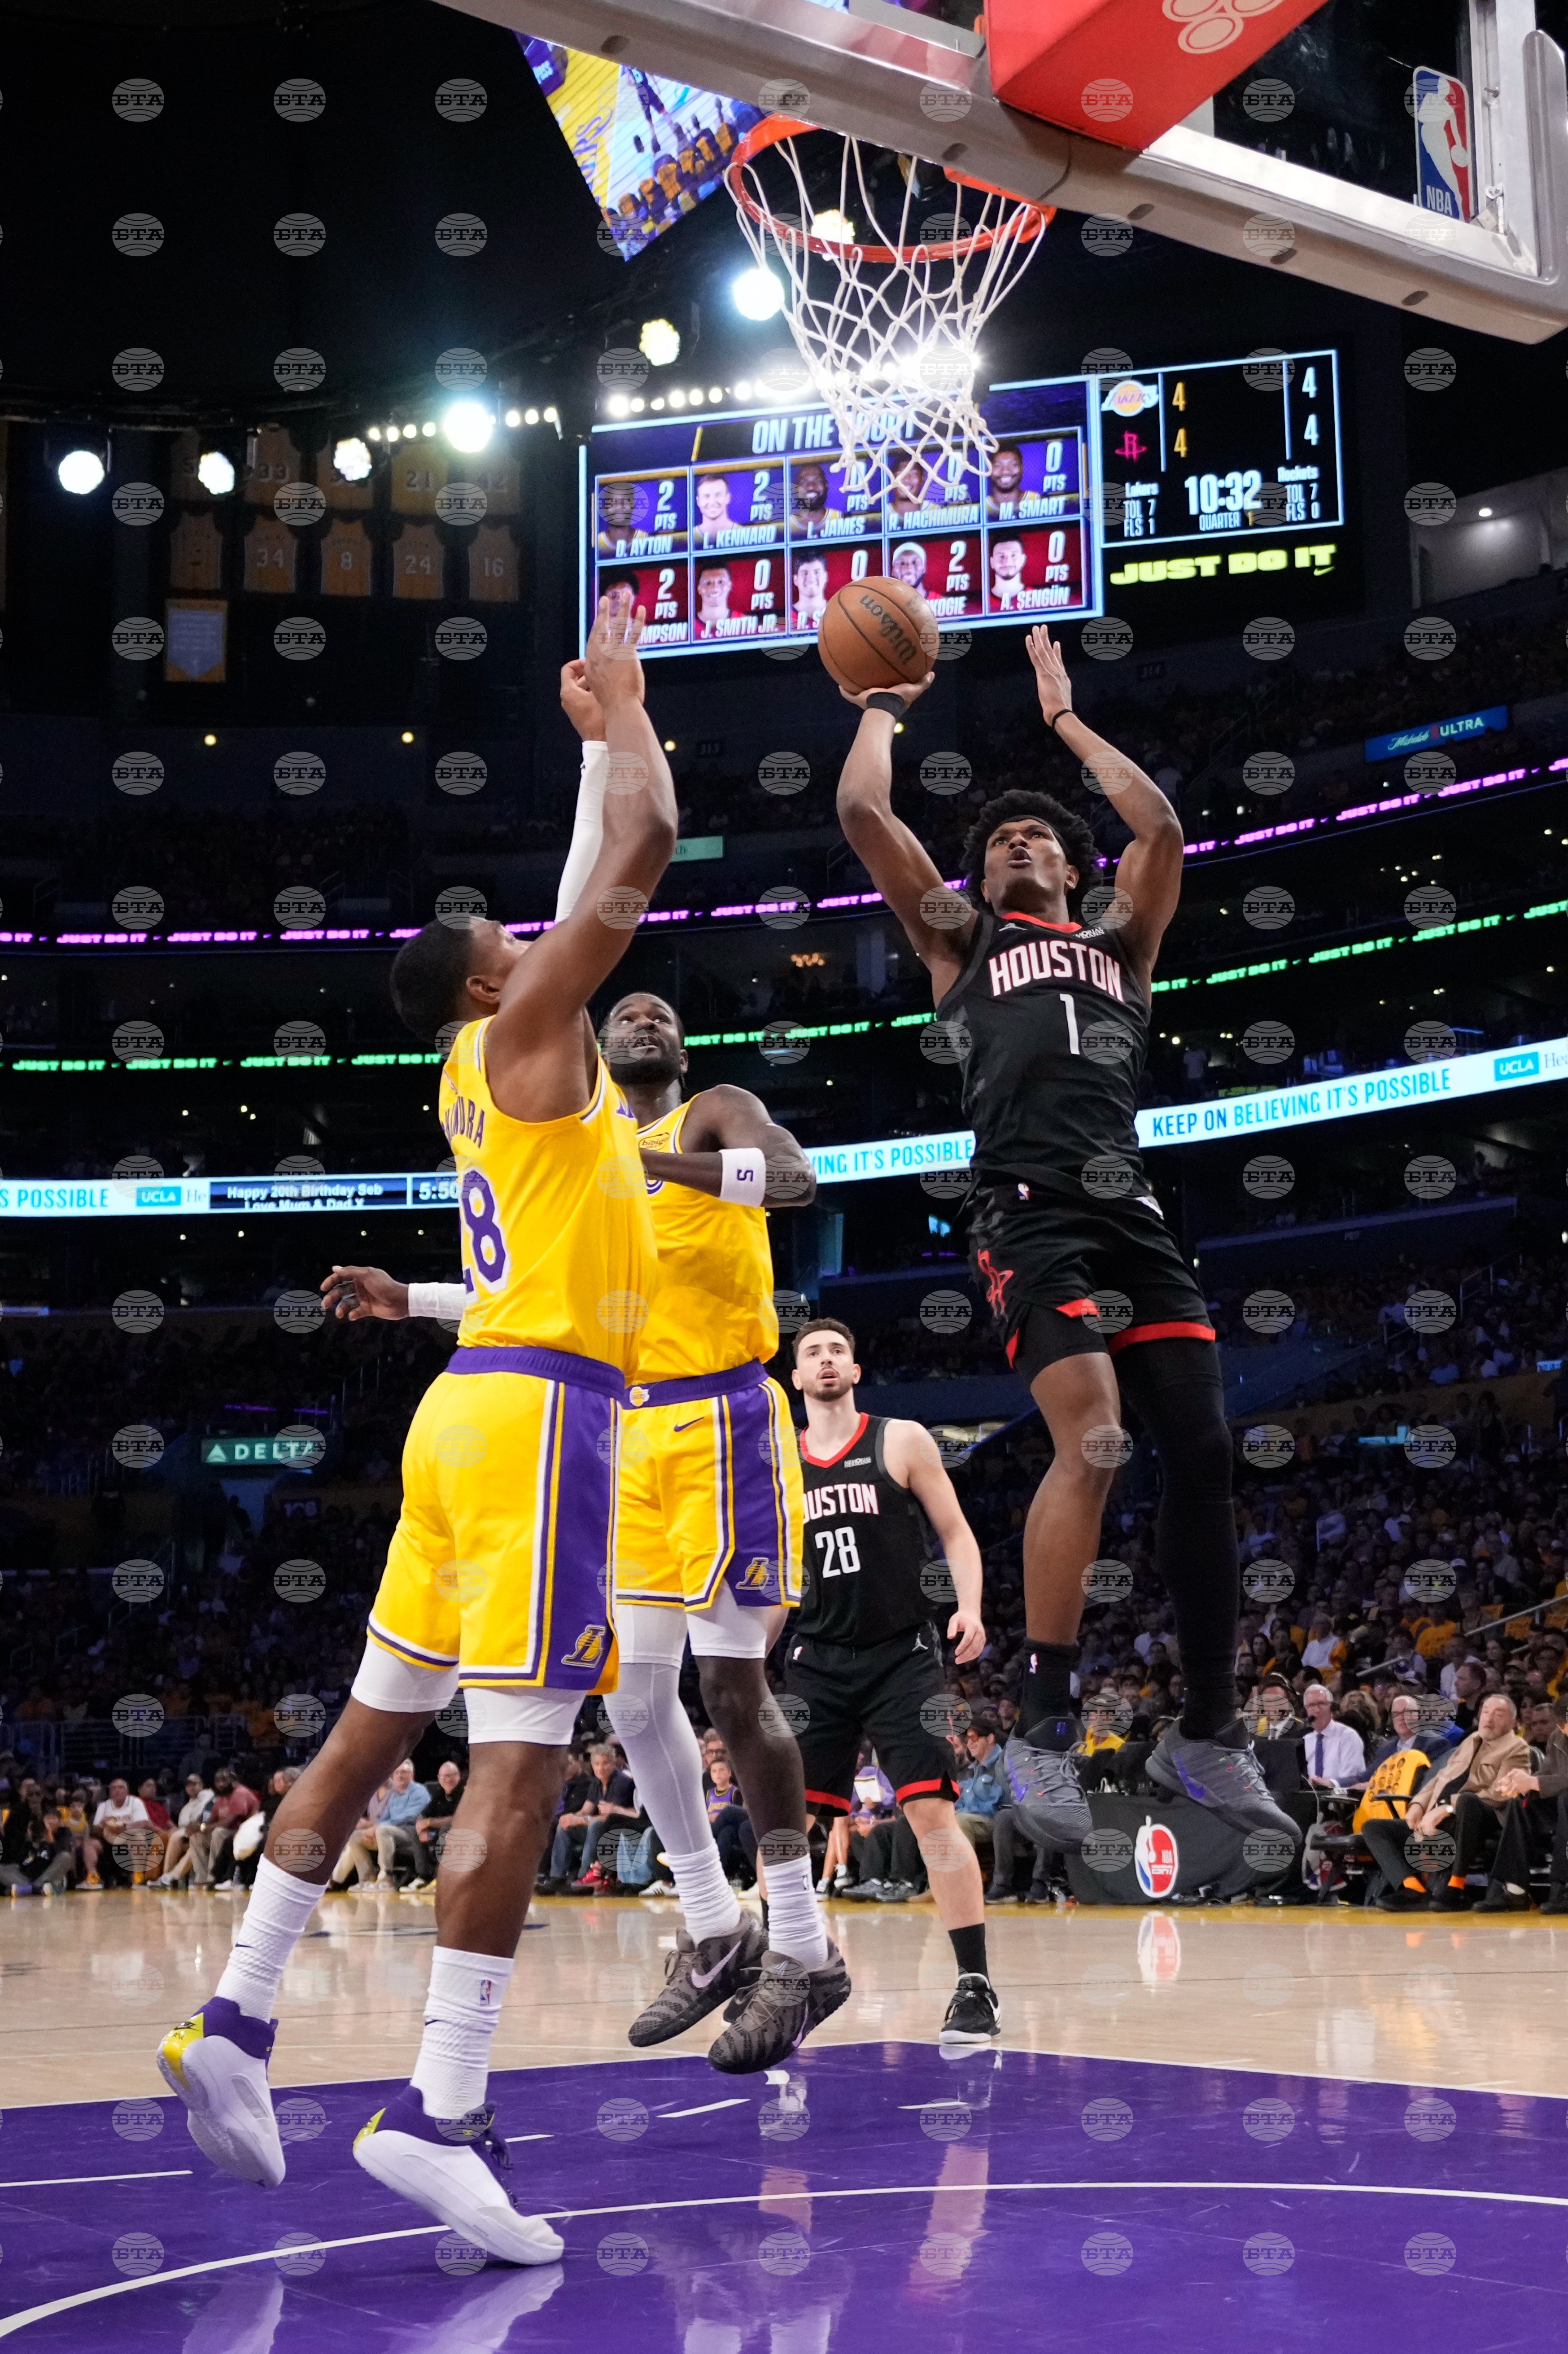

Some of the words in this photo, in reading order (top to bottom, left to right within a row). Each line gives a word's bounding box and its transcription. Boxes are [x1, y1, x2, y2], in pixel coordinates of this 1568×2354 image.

[1425, 184, 1453, 216] NBA
[1302, 366, 1316, 398] 4
[1172, 382, 1185, 411] 4
[752, 418, 788, 454] ON
[792, 414, 834, 450] THE
[839, 409, 916, 444] OURT
[1304, 414, 1319, 446] 4
[1174, 428, 1187, 458] 4
[948, 451, 963, 483] 0
[1046, 442, 1063, 473] 0
[1043, 474, 1067, 492] PTS
[1277, 465, 1319, 482] Rockets
[657, 480, 674, 512] 2
[753, 471, 770, 502] 2
[945, 484, 968, 502] PTS
[1125, 481, 1158, 497] Lakers
[1184, 470, 1262, 515] 10:32
[1285, 485, 1304, 503] TOL
[1311, 483, 1318, 500] 7
[750, 503, 773, 521] PTS
[847, 494, 868, 512] PTS
[999, 501, 1016, 521] M.
[1019, 497, 1066, 519] SMART
[1124, 499, 1143, 520] TOL
[1148, 499, 1156, 516] 7
[1286, 503, 1305, 521] FLS
[1311, 502, 1320, 519] 0
[654, 512, 677, 531] PTS
[808, 521, 818, 539] L.
[821, 516, 865, 538] JAMES
[889, 514, 901, 531] R.
[904, 505, 979, 530] HACHIMURA
[1124, 519, 1143, 537] FLS
[1149, 518, 1155, 534] 1
[1199, 512, 1240, 531] QUARTER
[1248, 511, 1254, 527] 1
[616, 539, 627, 558] D.
[630, 536, 673, 556] AYTON
[703, 532, 714, 550] L.
[716, 525, 777, 548] KENNARD
[1048, 531, 1066, 563] 0
[256, 549, 284, 569] 34
[340, 552, 353, 572] 8
[405, 554, 431, 576] 24
[851, 549, 869, 582] 0
[949, 540, 967, 573] 2
[1110, 555, 1221, 585] JUST
[1228, 549, 1288, 575] DO
[1294, 543, 1337, 568] IT
[657, 568, 675, 600] 2
[754, 559, 771, 591] 0
[946, 573, 970, 592] PTS
[1045, 564, 1070, 582] PTS
[655, 601, 678, 620] PTS
[751, 592, 774, 611] PTS
[927, 595, 968, 617] KOGIE
[1000, 593, 1014, 611] A.
[701, 624, 712, 639] J.
[716, 617, 756, 636] SMITH
[758, 614, 778, 634] JR.
[797, 612, 809, 630] R.
[859, 594, 917, 665] Wilson
[625, 622, 688, 644] MPSON
[1440, 717, 1485, 737] ULTRA
[1437, 779, 1481, 797] JUST
[1508, 768, 1525, 781] IT
[1336, 803, 1378, 821] JUST
[1403, 793, 1420, 805] IT
[711, 905, 754, 917] JUST
[780, 901, 797, 911] IT
[57, 934, 102, 944] JUST
[130, 933, 147, 943] IT
[167, 932, 212, 942] JUST
[240, 931, 257, 941] IT
[1412, 924, 1456, 942] JUST
[1483, 915, 1501, 927] IT
[1307, 946, 1350, 963] JUST
[1376, 937, 1393, 949] IT
[989, 940, 1124, 1002] HOUSTON
[785, 1026, 828, 1039] JUST
[854, 1021, 870, 1032] IT
[1059, 993, 1080, 1054] 1
[13, 1060, 60, 1071] JUST
[88, 1060, 105, 1071] IT
[351, 1054, 397, 1065] JUST
[424, 1053, 441, 1063] IT
[1153, 1112, 1198, 1138] KEEP
[1204, 1107, 1227, 1130] ON
[1234, 1092, 1321, 1127] BELIEVING
[1327, 1085, 1358, 1108] IT'S
[1365, 1068, 1451, 1103] POSSIBLE
[1499, 1059, 1534, 1075] UCLA
[854, 1149, 884, 1172] IT'S
[891, 1139, 973, 1167] POSSIBLE
[736, 1168, 754, 1182] 5
[17, 1188, 109, 1208] POSSIBLE
[142, 1191, 176, 1203] UCLA
[227, 1186, 268, 1201] Happy
[271, 1186, 298, 1198] 20th
[301, 1185, 354, 1199] Birthday
[358, 1183, 383, 1196] Seb
[245, 1201, 276, 1210] Love
[279, 1200, 310, 1209] Mum
[314, 1199, 323, 1208] &
[327, 1199, 350, 1208] Dad
[355, 1198, 365, 1208] X
[462, 1170, 509, 1294] 8
[815, 1526, 860, 1578] 28
